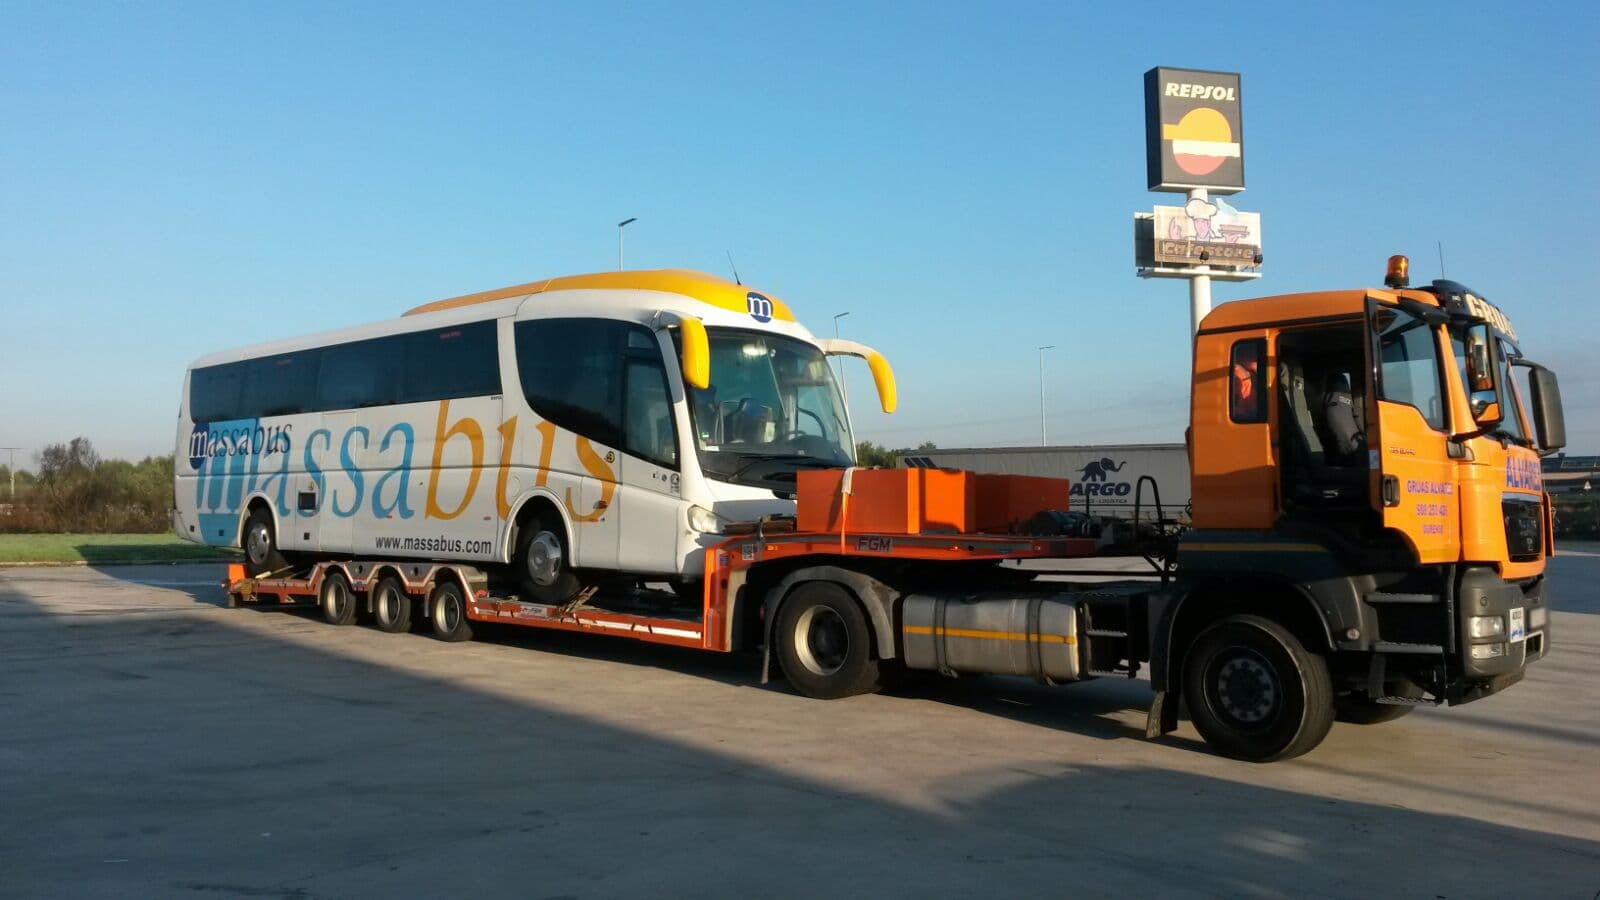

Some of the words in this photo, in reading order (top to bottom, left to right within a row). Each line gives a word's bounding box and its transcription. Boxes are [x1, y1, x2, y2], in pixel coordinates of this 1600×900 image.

[1165, 82, 1235, 101] REPSOL
[189, 417, 293, 459] massabus
[196, 399, 618, 523] massabus
[375, 535, 492, 554] www.massabus.com
[857, 535, 891, 552] FGM
